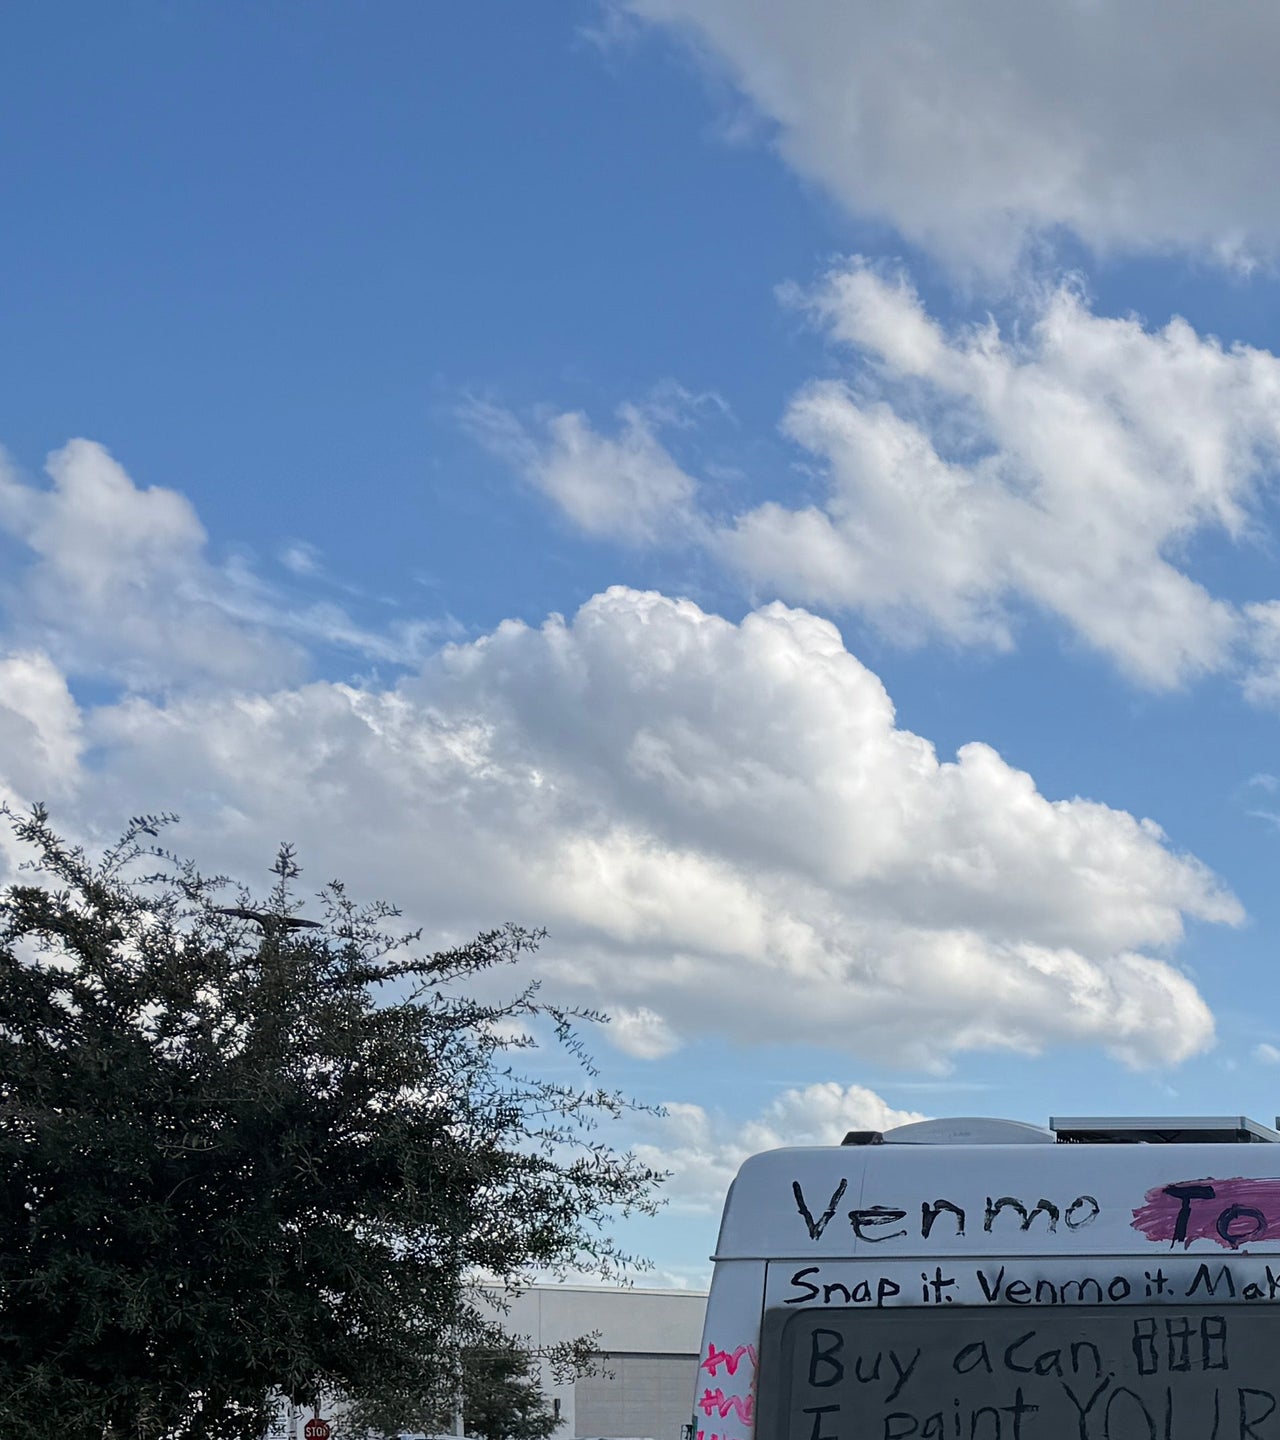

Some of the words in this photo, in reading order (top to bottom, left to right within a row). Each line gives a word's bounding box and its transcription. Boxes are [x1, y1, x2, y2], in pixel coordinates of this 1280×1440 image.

[792, 1178, 1101, 1243] Venmo
[1162, 1185, 1268, 1250] To
[784, 1266, 901, 1307] Snap
[921, 1266, 957, 1304] it.
[977, 1265, 1131, 1304] Venmo
[1145, 1268, 1175, 1296] it.
[808, 1328, 920, 1403] Buy
[953, 1340, 994, 1374] a
[305, 1425, 328, 1438] STOP
